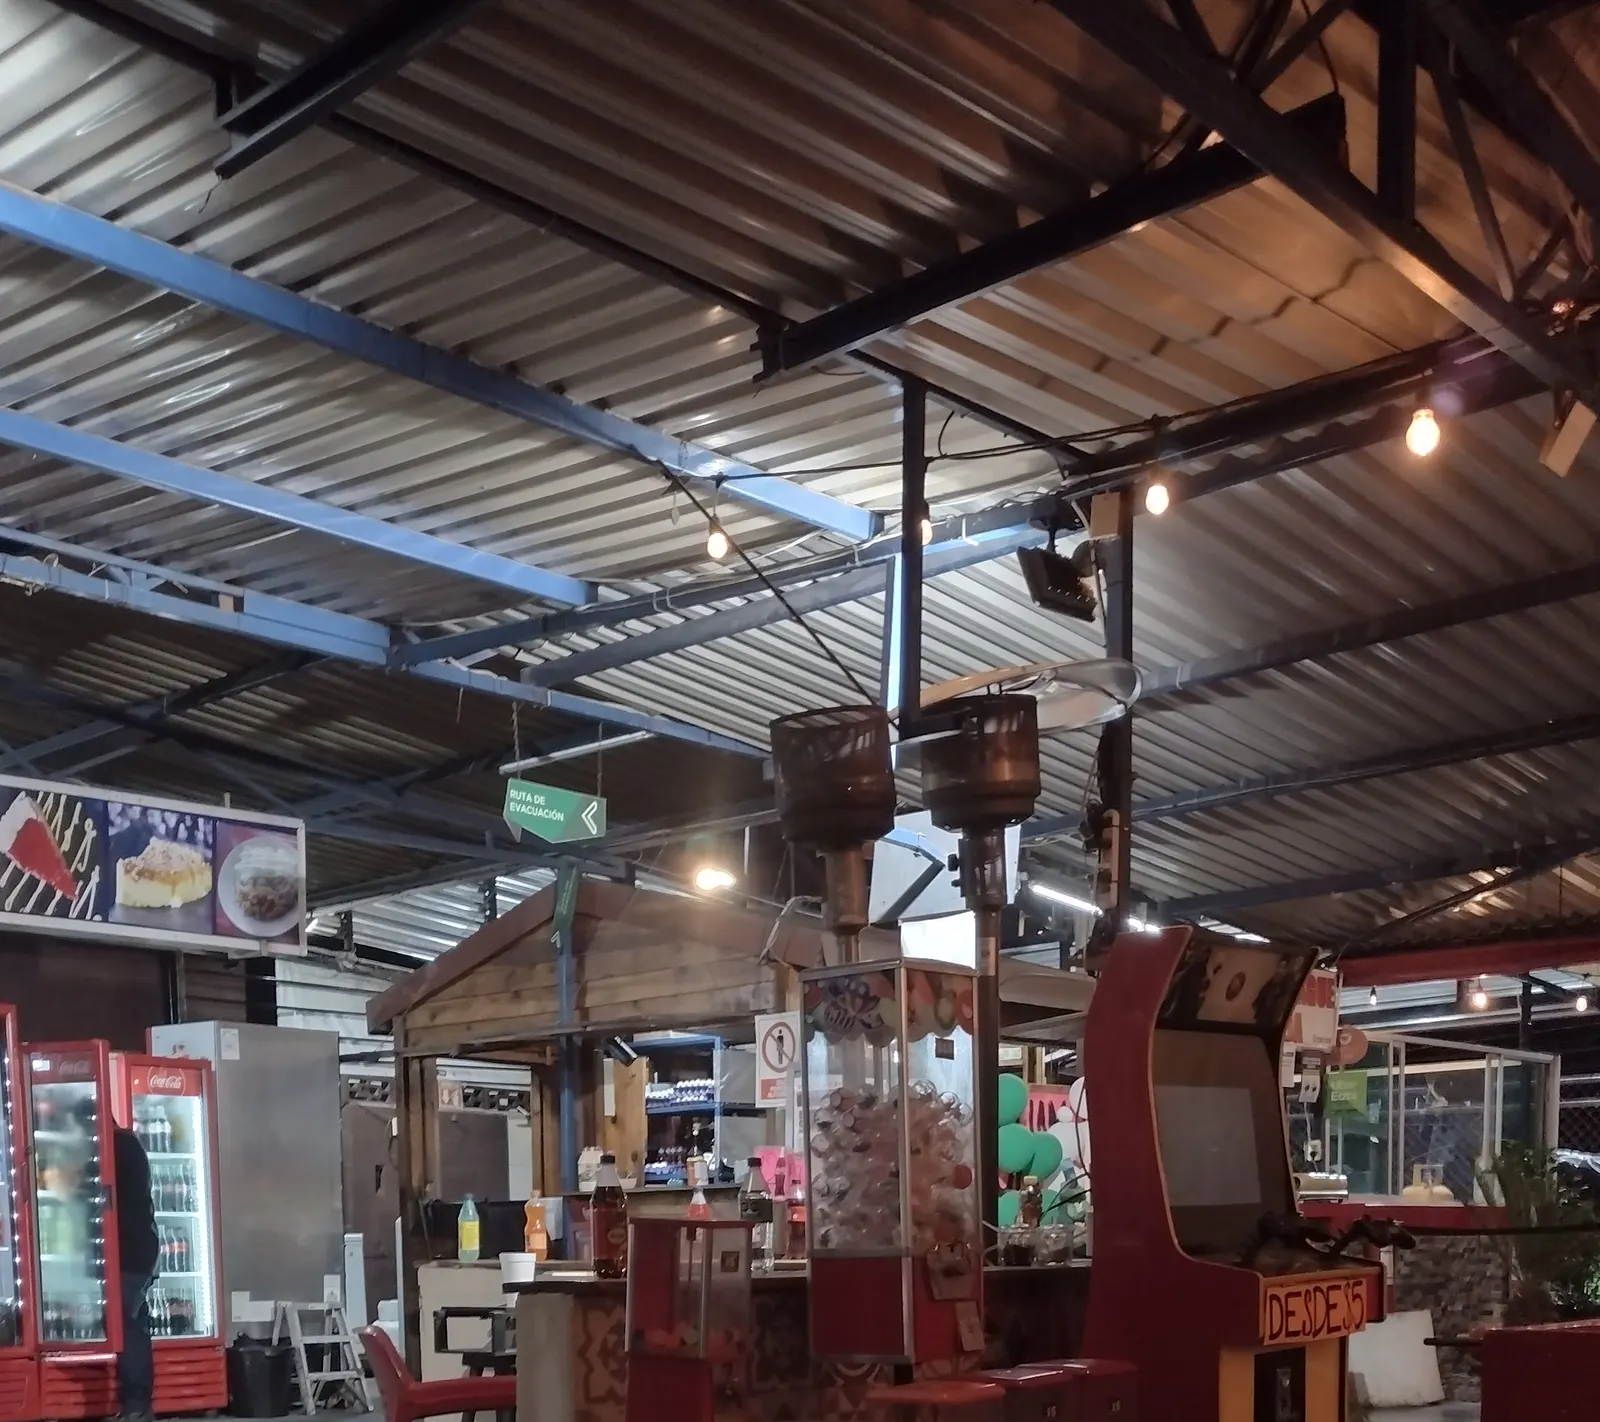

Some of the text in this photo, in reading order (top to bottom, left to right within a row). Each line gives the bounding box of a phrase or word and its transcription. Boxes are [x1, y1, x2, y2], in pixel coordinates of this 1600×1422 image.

[510, 790, 546, 806] RUTA DE
[509, 803, 564, 822] EVACUACIÓN
[1268, 1284, 1342, 1341] DESDE
